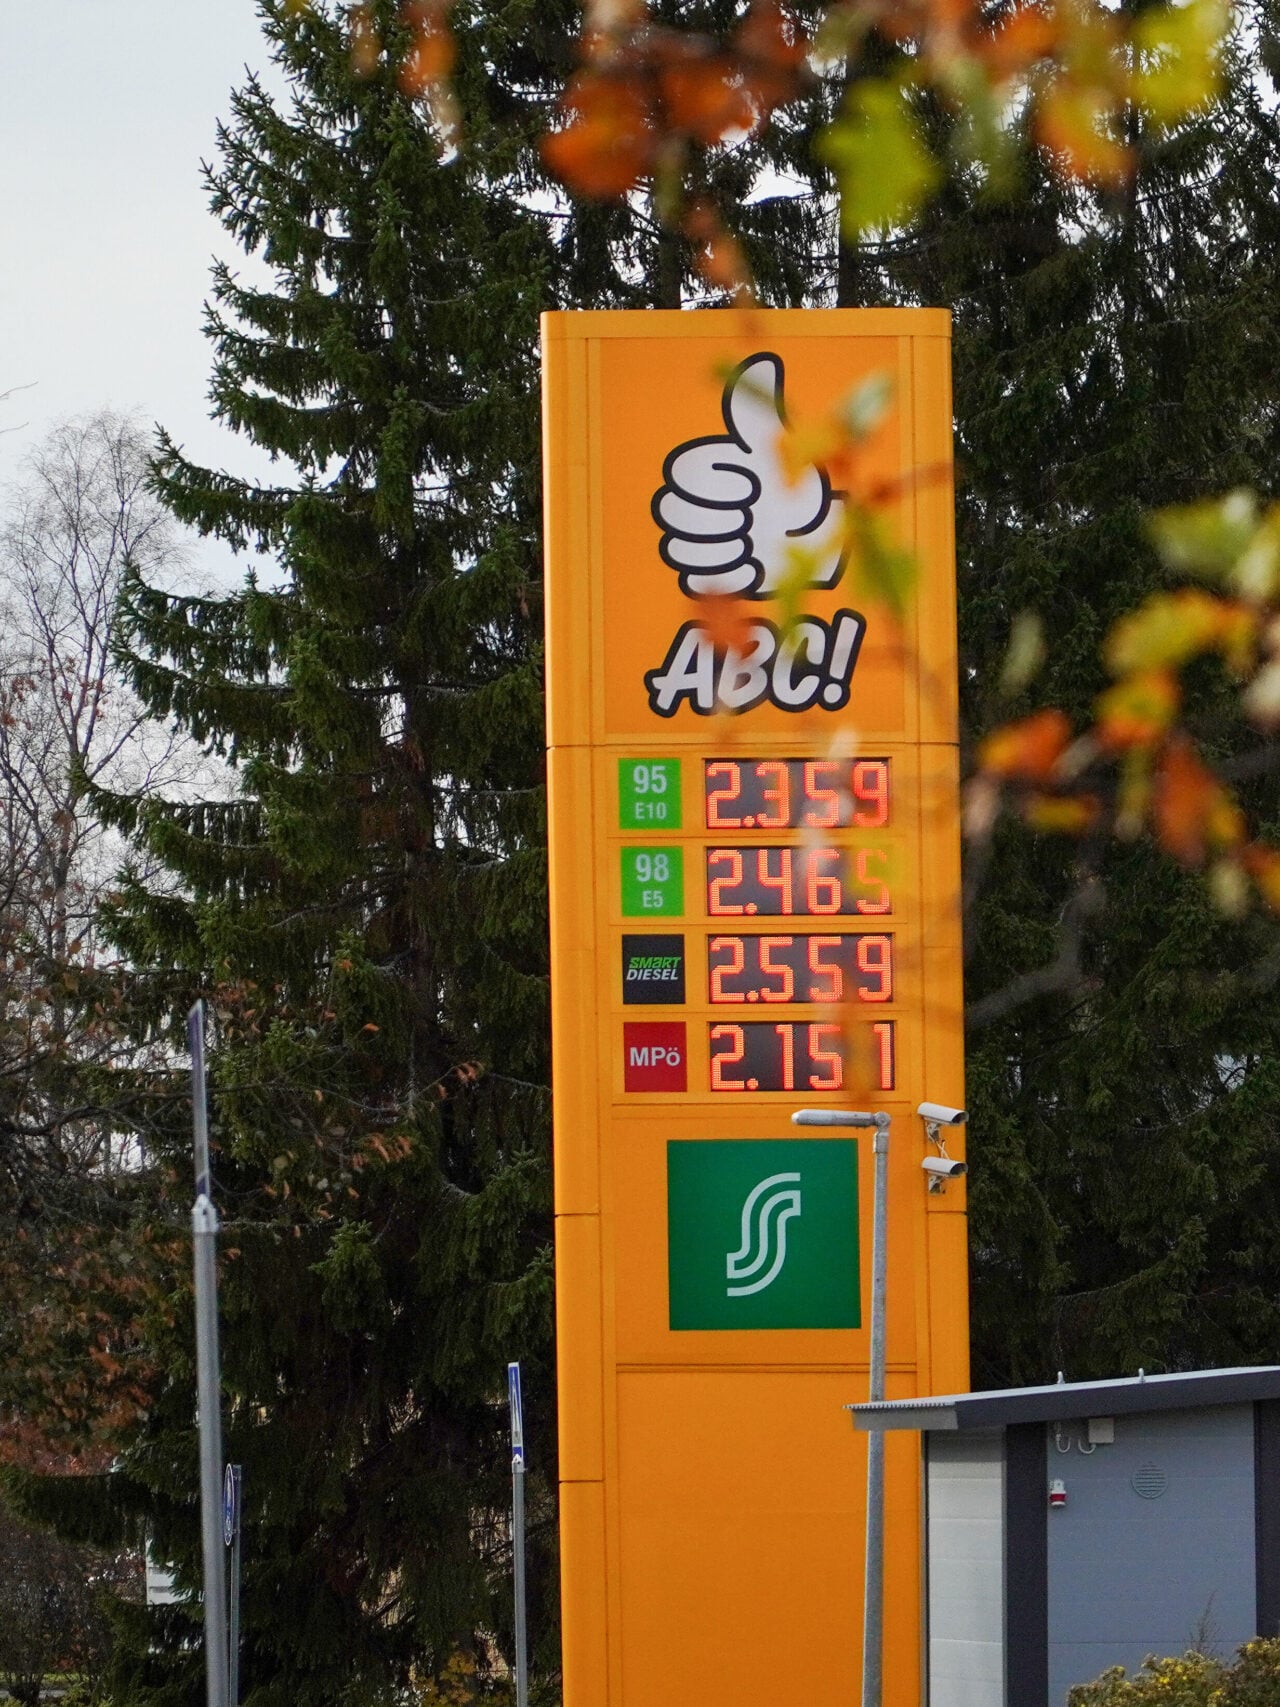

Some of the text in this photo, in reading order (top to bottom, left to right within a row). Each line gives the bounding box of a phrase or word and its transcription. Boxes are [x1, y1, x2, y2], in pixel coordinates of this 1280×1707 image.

[648, 610, 863, 716] ABC!
[633, 765, 667, 794] 95
[706, 761, 889, 828] 2.359
[635, 803, 667, 819] E10
[635, 854, 669, 882] 98
[709, 849, 890, 915] 2.465
[642, 891, 664, 908] E5
[626, 969, 679, 980] DIESEL
[710, 936, 892, 1002] 2.559
[630, 1047, 680, 1066] MPö
[710, 1024, 892, 1090] 2.151
